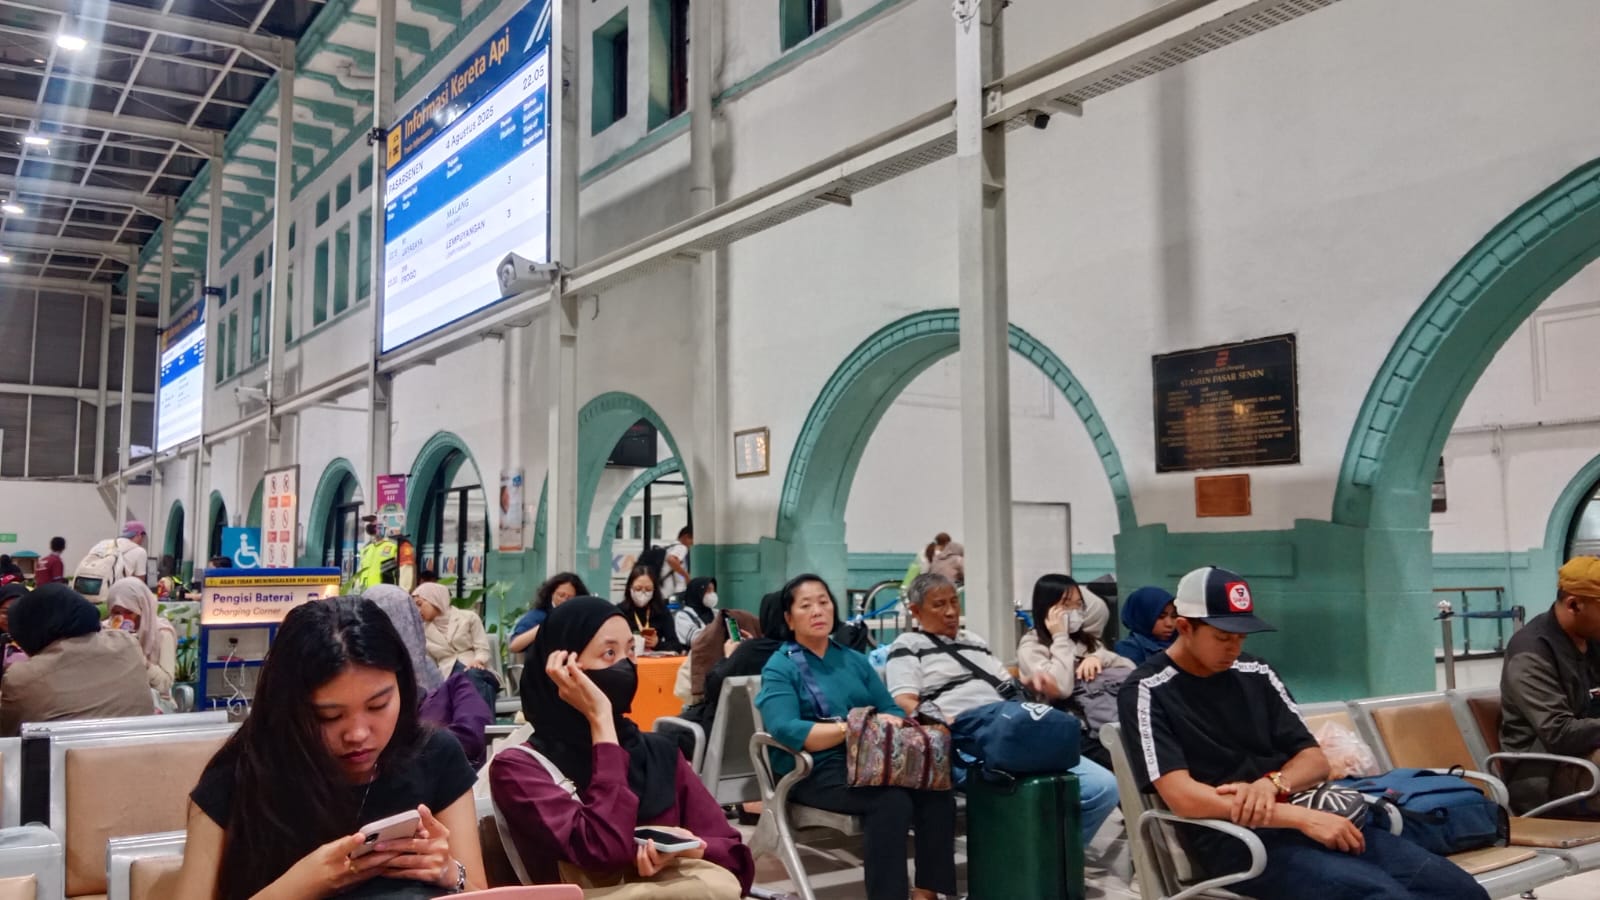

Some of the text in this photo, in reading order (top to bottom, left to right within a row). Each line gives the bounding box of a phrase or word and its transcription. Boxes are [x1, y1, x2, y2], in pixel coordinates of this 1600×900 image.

[404, 27, 510, 139] Informasi Kereta Api
[451, 122, 476, 146] Agustus
[477, 105, 495, 127] 2025
[522, 65, 545, 91] 22.05
[446, 198, 470, 218] MALANG
[213, 591, 293, 605] Pengisi Baterai
[213, 607, 281, 617] Charging Corner
